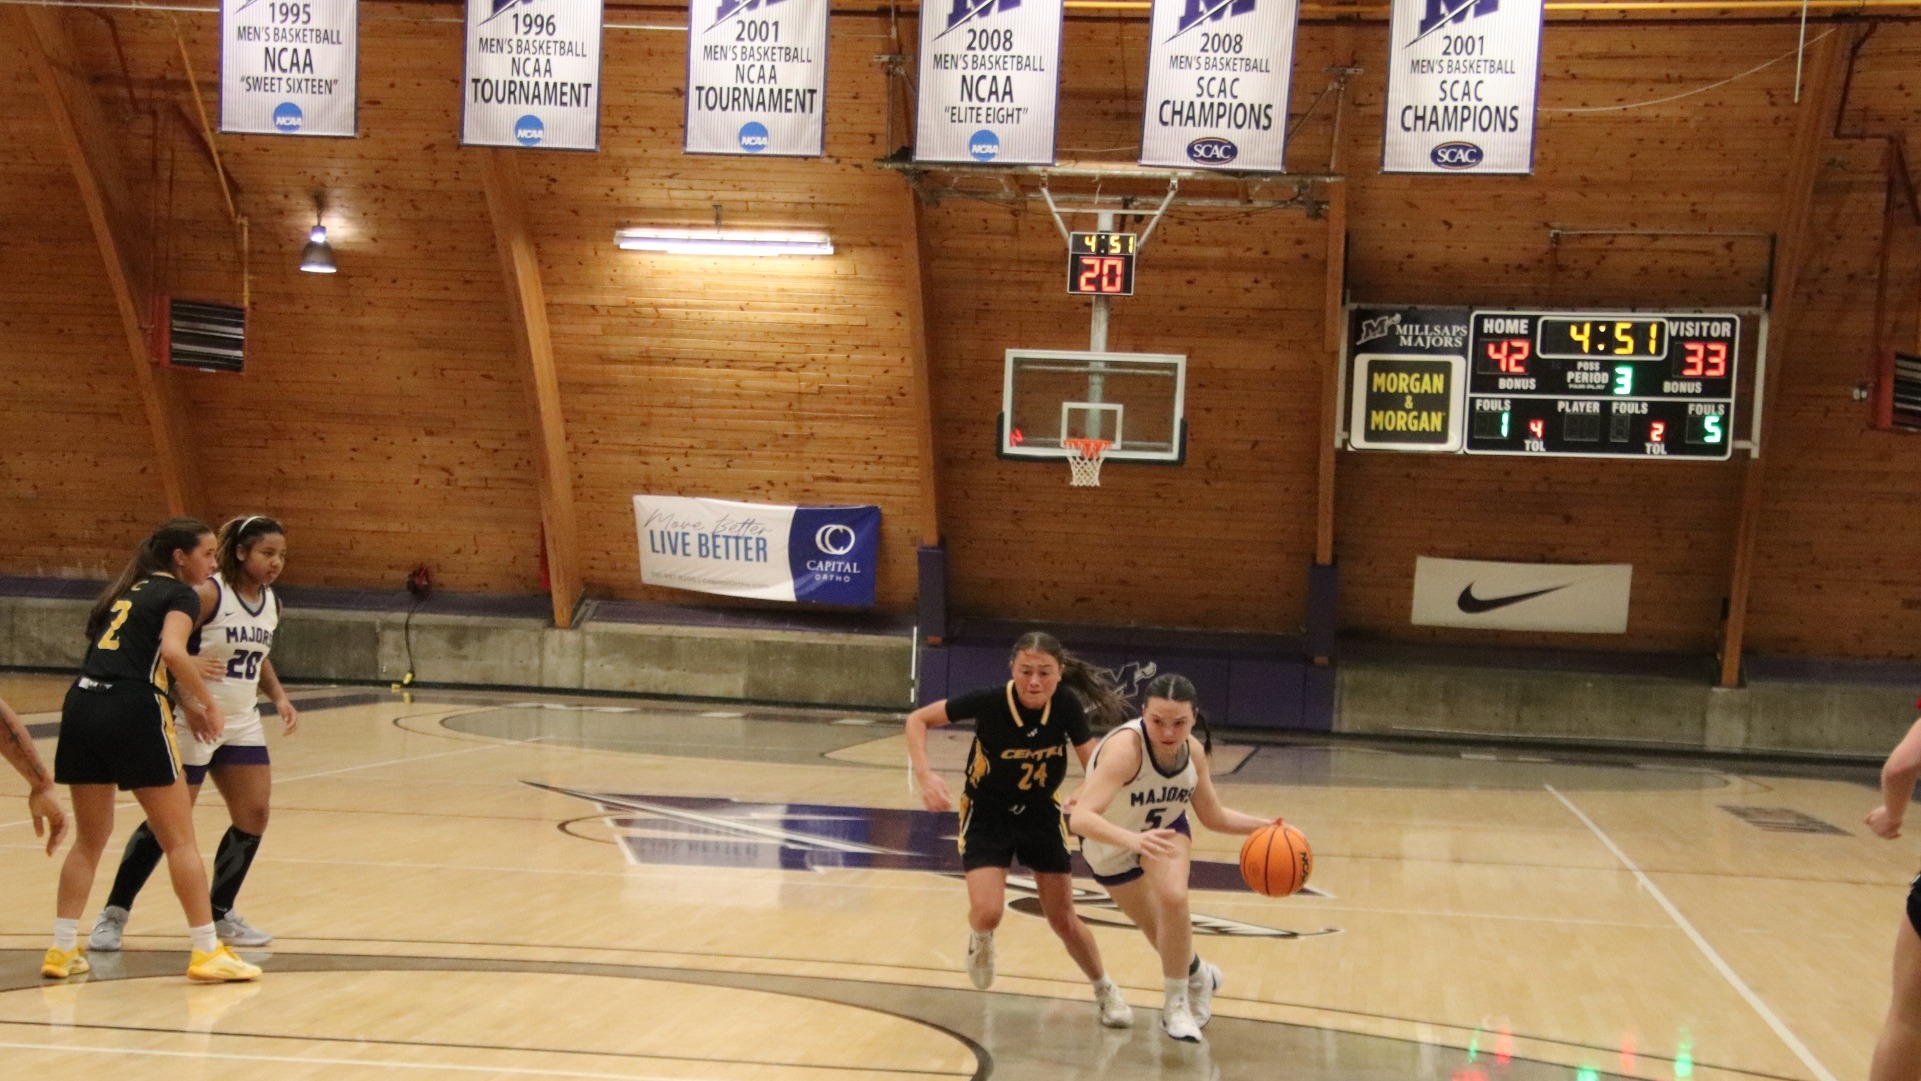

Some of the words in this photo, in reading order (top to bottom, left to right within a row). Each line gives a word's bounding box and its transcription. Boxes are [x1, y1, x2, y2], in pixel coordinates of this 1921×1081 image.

[269, 3, 311, 24] 1995
[512, 13, 556, 36] 1996
[735, 20, 779, 42] 2001
[237, 26, 270, 41] MEN'S
[273, 27, 342, 45] BASKETBALL
[966, 29, 1013, 51] 2008
[1200, 33, 1243, 54] 2008
[478, 37, 513, 54] MEN'S
[516, 39, 587, 57] BASKETBALL
[703, 45, 738, 60] MEN'S
[741, 46, 812, 63] BASKETBALL
[1442, 36, 1484, 56] 2001
[264, 47, 314, 74] NCAA
[511, 57, 552, 78] NCAA
[933, 54, 969, 70] MEN'S
[971, 55, 1045, 71] BASKETBALL
[1169, 56, 1201, 70] MEN'S
[1205, 57, 1270, 73] BASKETBALL
[1410, 60, 1443, 74] MEN'S
[1447, 60, 1516, 74] BASKETBALL
[735, 64, 777, 84] NCAA
[240, 76, 283, 93] "SWEET
[286, 78, 338, 95] SIXTEEN"
[471, 78, 592, 108] TOURNAMENT
[960, 75, 1014, 103] NCAA
[1196, 77, 1240, 99] SCAC
[1439, 80, 1484, 102] SCAC
[695, 86, 817, 114] TOURNAMENT
[276, 117, 302, 126] NCAA
[944, 107, 982, 123] "ELITE
[986, 107, 1029, 125] EIGHT"
[1159, 100, 1273, 131] CHAMPIONS
[1401, 105, 1519, 133] CHAMPIONS
[517, 129, 544, 138] NCAA
[741, 136, 768, 146] NCAA
[972, 145, 999, 154] NCAA
[1193, 145, 1231, 158] SCAC
[1437, 150, 1477, 163] SCAC
[1084, 235, 1133, 254] 4:51
[1080, 258, 1122, 292] 20
[1396, 324, 1468, 337] MILLSAPS
[1483, 318, 1529, 335] HOME
[1669, 321, 1732, 337] VISITOR
[1400, 336, 1463, 349] MAJORS
[1569, 322, 1658, 355] 4:51
[1488, 340, 1530, 373] 42
[1577, 361, 1600, 371] POSS
[1682, 341, 1728, 377] 33
[1373, 372, 1444, 394] MORGAN
[1498, 378, 1536, 390] BONUS
[1566, 371, 1609, 384] PERIOD
[1614, 366, 1633, 395] 3
[1663, 381, 1702, 393] BONUS
[1404, 395, 1413, 409] &
[1475, 399, 1511, 411] FOULS
[1557, 401, 1600, 413] PLAYER
[1612, 402, 1648, 414] FOULS
[1688, 404, 1725, 416] FOULS
[1371, 410, 1442, 432] MORGAN
[1501, 412, 1509, 437] 1
[1530, 420, 1542, 438] 4
[1703, 416, 1722, 443] 5
[1651, 422, 1664, 442] 2
[1524, 440, 1546, 452] TOL
[1645, 443, 1667, 455] TOL
[644, 509, 703, 531] Move
[649, 529, 691, 557] LIVE
[698, 533, 768, 562] BETTER
[806, 560, 861, 574] CAPITAL
[815, 574, 851, 583] ORTHO
[98, 601, 132, 650] 2
[226, 649, 263, 680] 20
[1018, 762, 1048, 790] 24
[1141, 807, 1168, 833] 5
